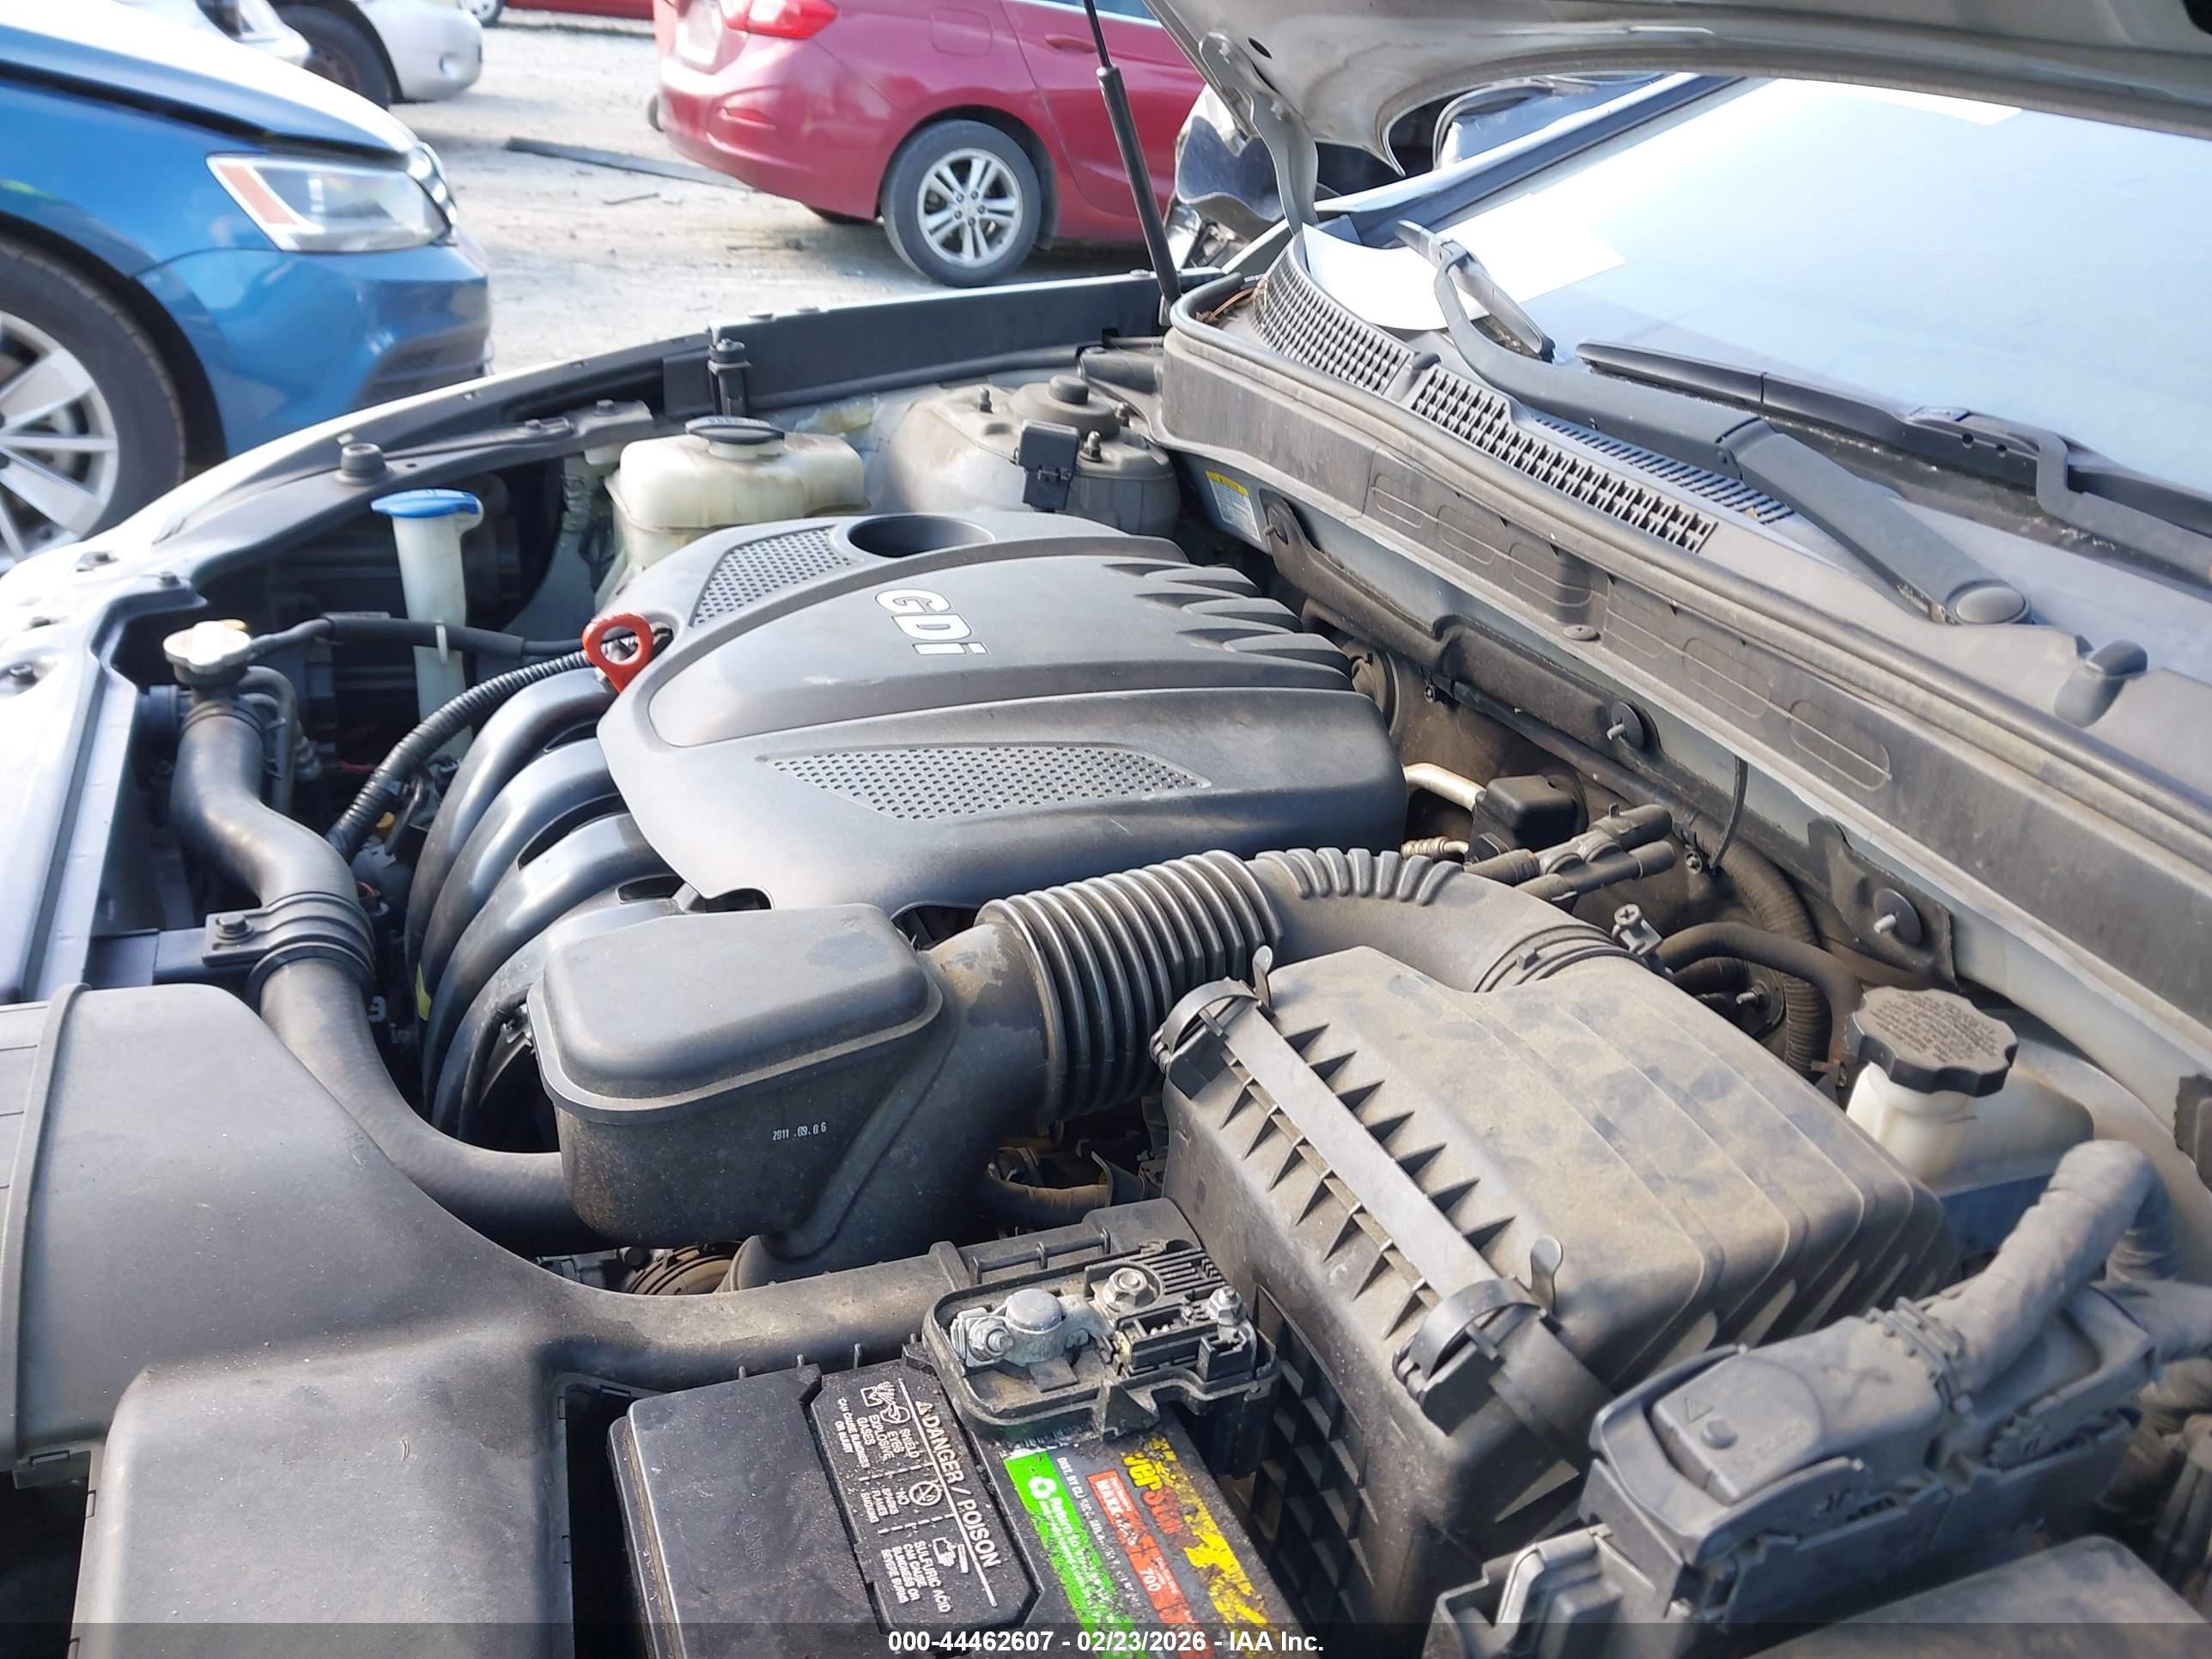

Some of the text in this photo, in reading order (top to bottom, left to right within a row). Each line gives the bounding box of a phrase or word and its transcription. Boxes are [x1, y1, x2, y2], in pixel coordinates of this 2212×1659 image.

[837, 1398, 849, 1412] CAN
[855, 1416, 876, 1445] GASES
[868, 1413, 894, 1461] EXPLOSIVE
[886, 1431, 904, 1454] EYES
[899, 1427, 919, 1458] SHIELD
[1056, 1456, 1073, 1475] DIST.
[1065, 1474, 1079, 1486] BY
[870, 1489, 888, 1516] FLAMES
[881, 1487, 898, 1515] SPARKS
[895, 1490, 909, 1505] NO
[921, 1414, 963, 1484] DANGER
[956, 1497, 1000, 1568] POISON
[880, 1548, 908, 1603] SEVERE BURNS
[891, 1546, 920, 1600] BLINDNESS OR
[902, 1543, 927, 1588] CAN CAUSE
[914, 1540, 951, 1613] SULFURIC ACID
[1139, 1566, 1162, 1593] 700
